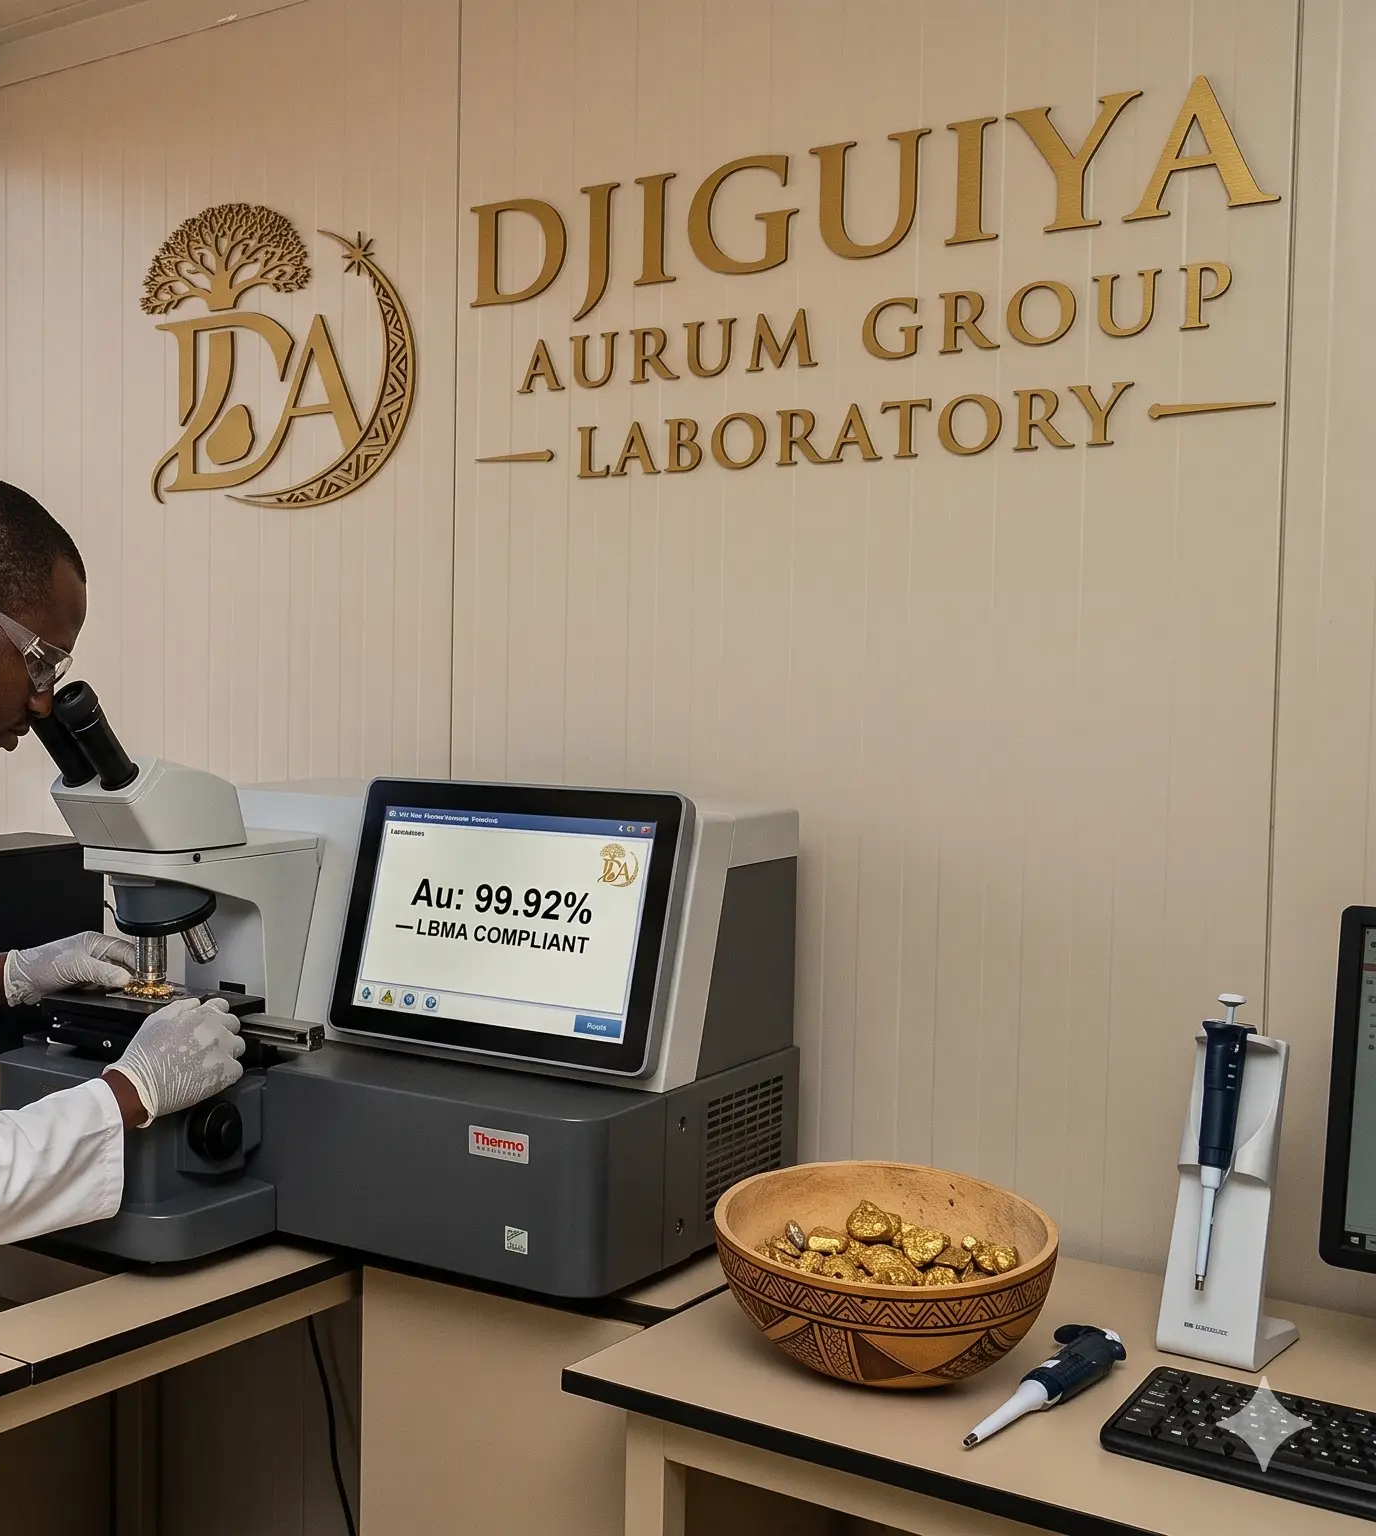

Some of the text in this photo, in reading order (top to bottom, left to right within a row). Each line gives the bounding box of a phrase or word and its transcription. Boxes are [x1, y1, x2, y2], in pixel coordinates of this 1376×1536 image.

[469, 74, 1280, 322] DJIGUIYA
[518, 261, 1234, 395] AURUM GROUP
[577, 381, 1136, 479] LABORATORY
[411, 878, 593, 925] Au: 99.92%
[474, 924, 590, 954] COMPLIANT
[473, 1131, 524, 1152] Thermo
